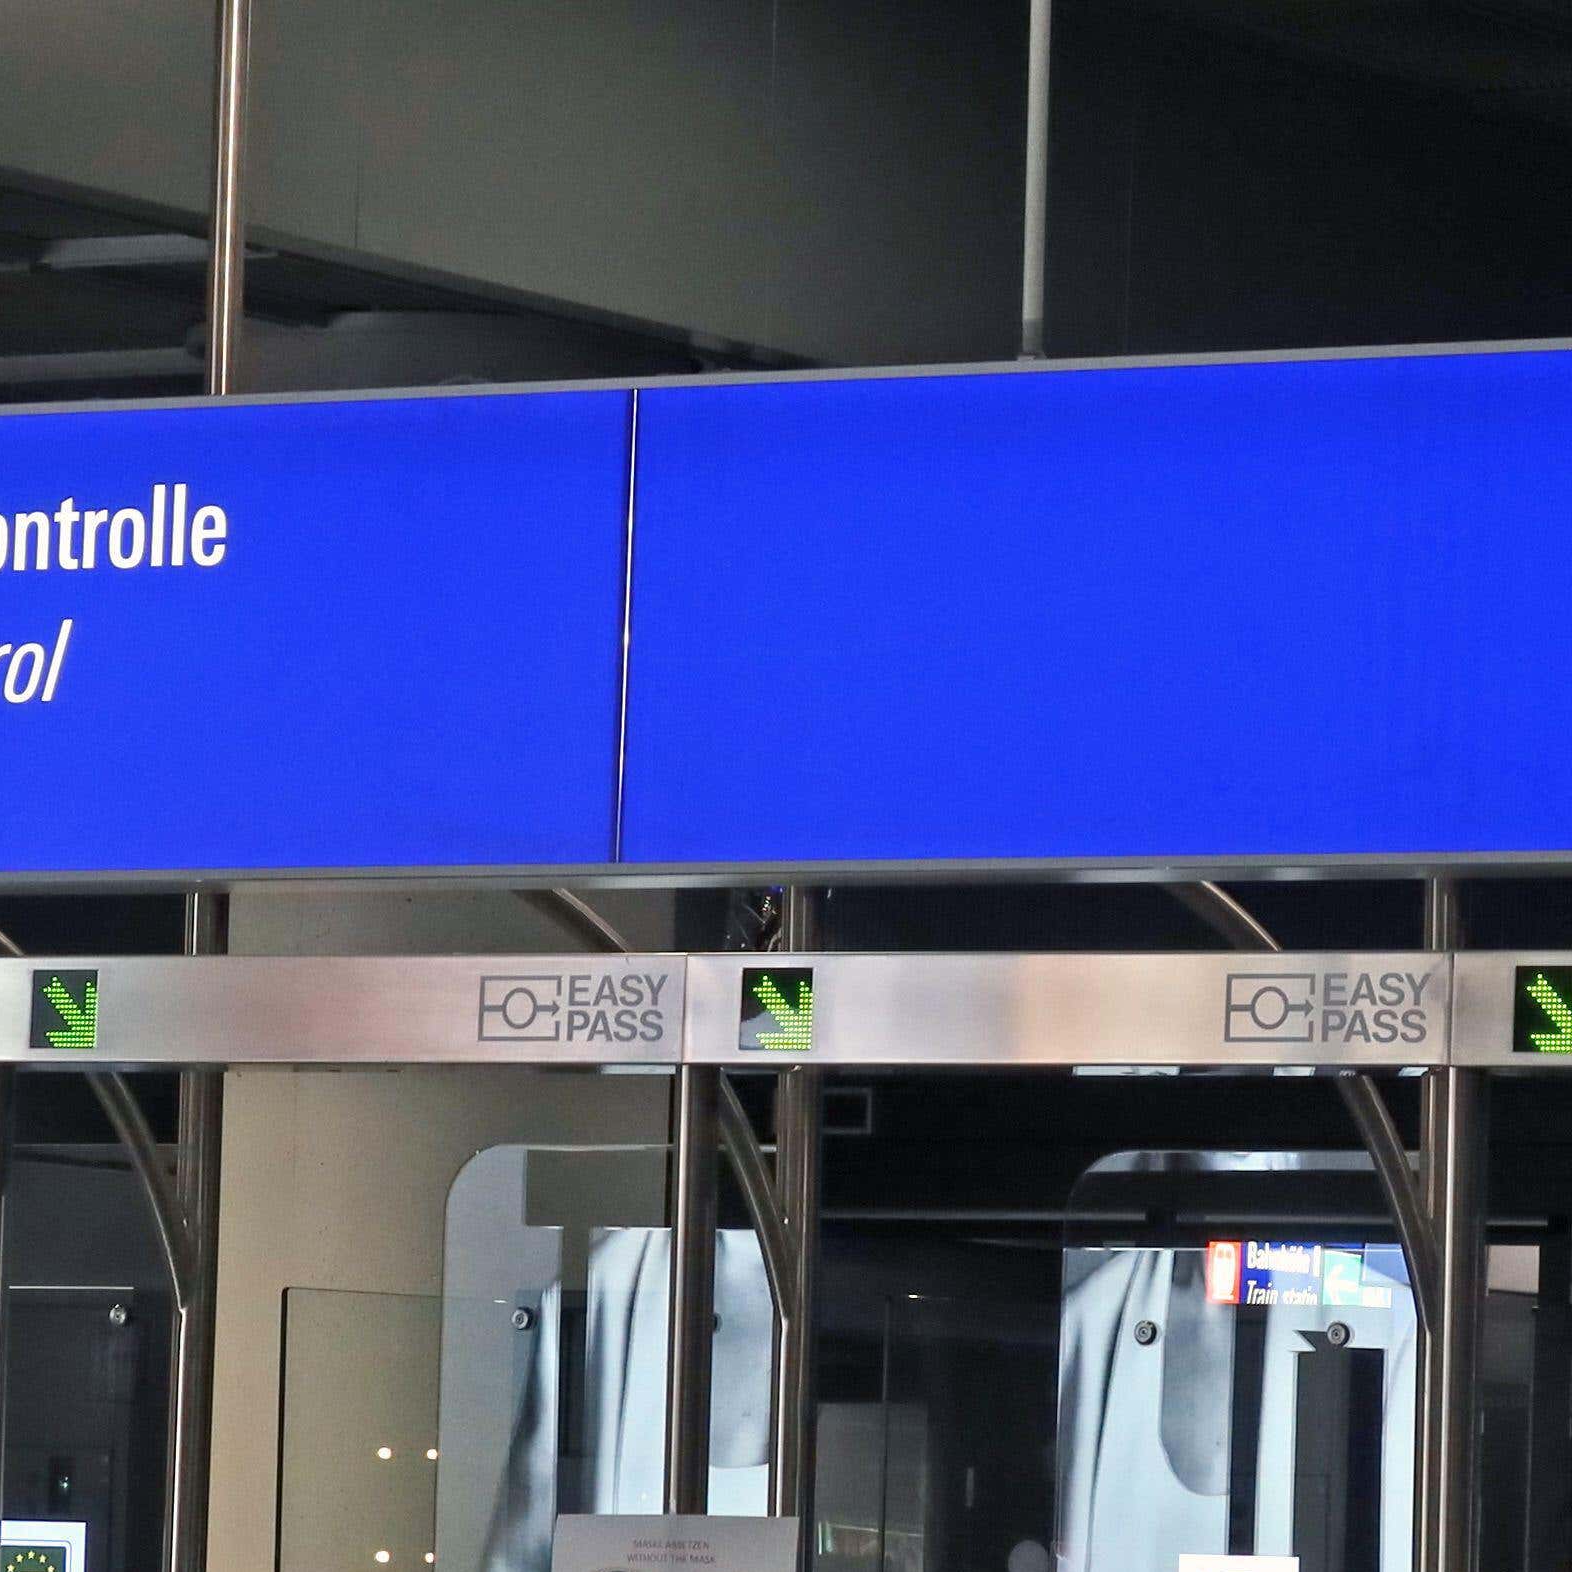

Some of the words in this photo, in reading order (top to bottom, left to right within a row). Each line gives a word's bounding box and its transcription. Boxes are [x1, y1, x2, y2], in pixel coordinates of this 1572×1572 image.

[567, 974, 669, 1007] EASY
[1322, 972, 1431, 1007] EASY
[566, 1009, 664, 1042] PASS
[1321, 1009, 1427, 1043] PASS
[1246, 1280, 1279, 1305] Train
